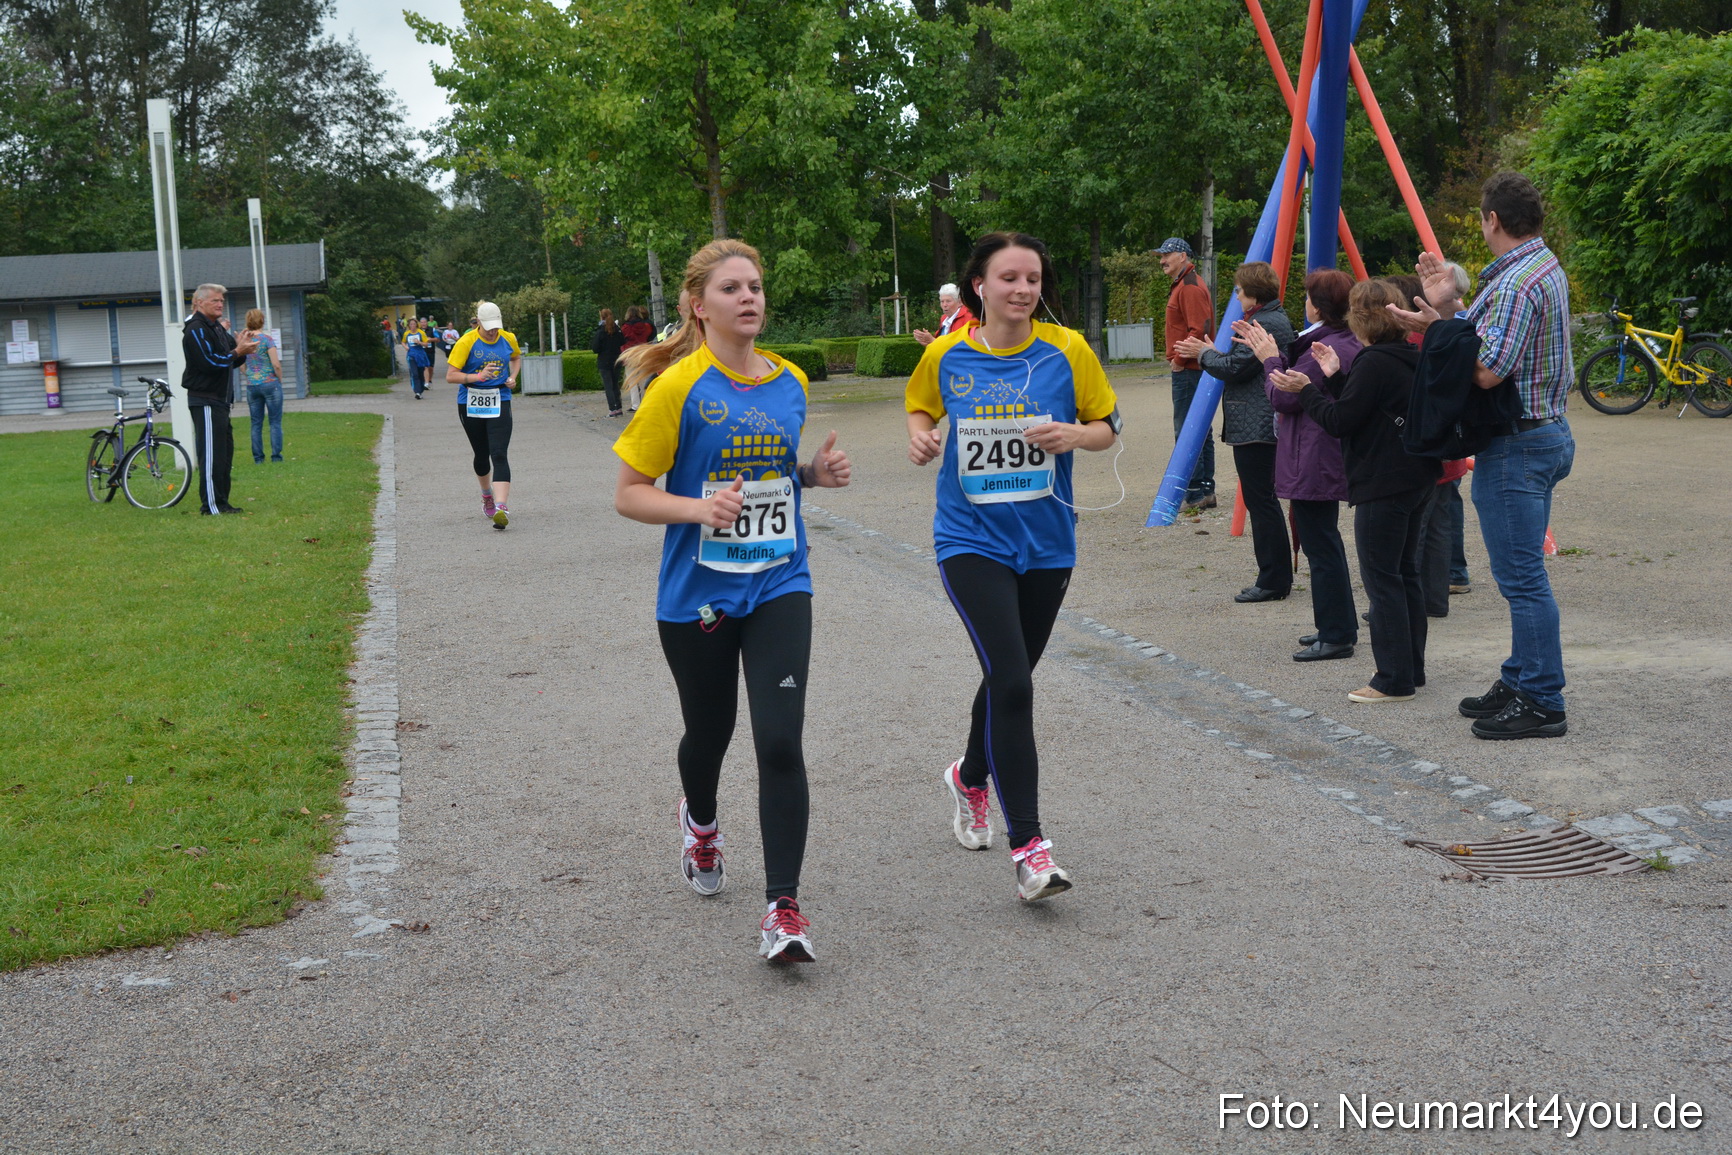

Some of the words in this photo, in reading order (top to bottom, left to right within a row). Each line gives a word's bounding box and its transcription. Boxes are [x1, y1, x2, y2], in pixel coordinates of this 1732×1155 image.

[470, 396, 496, 406] 2881
[959, 427, 988, 436] PARTL
[967, 439, 1045, 471] 2498
[982, 477, 1032, 491] Jennifer
[742, 489, 782, 499] Neumarkt
[727, 546, 775, 560] Martina
